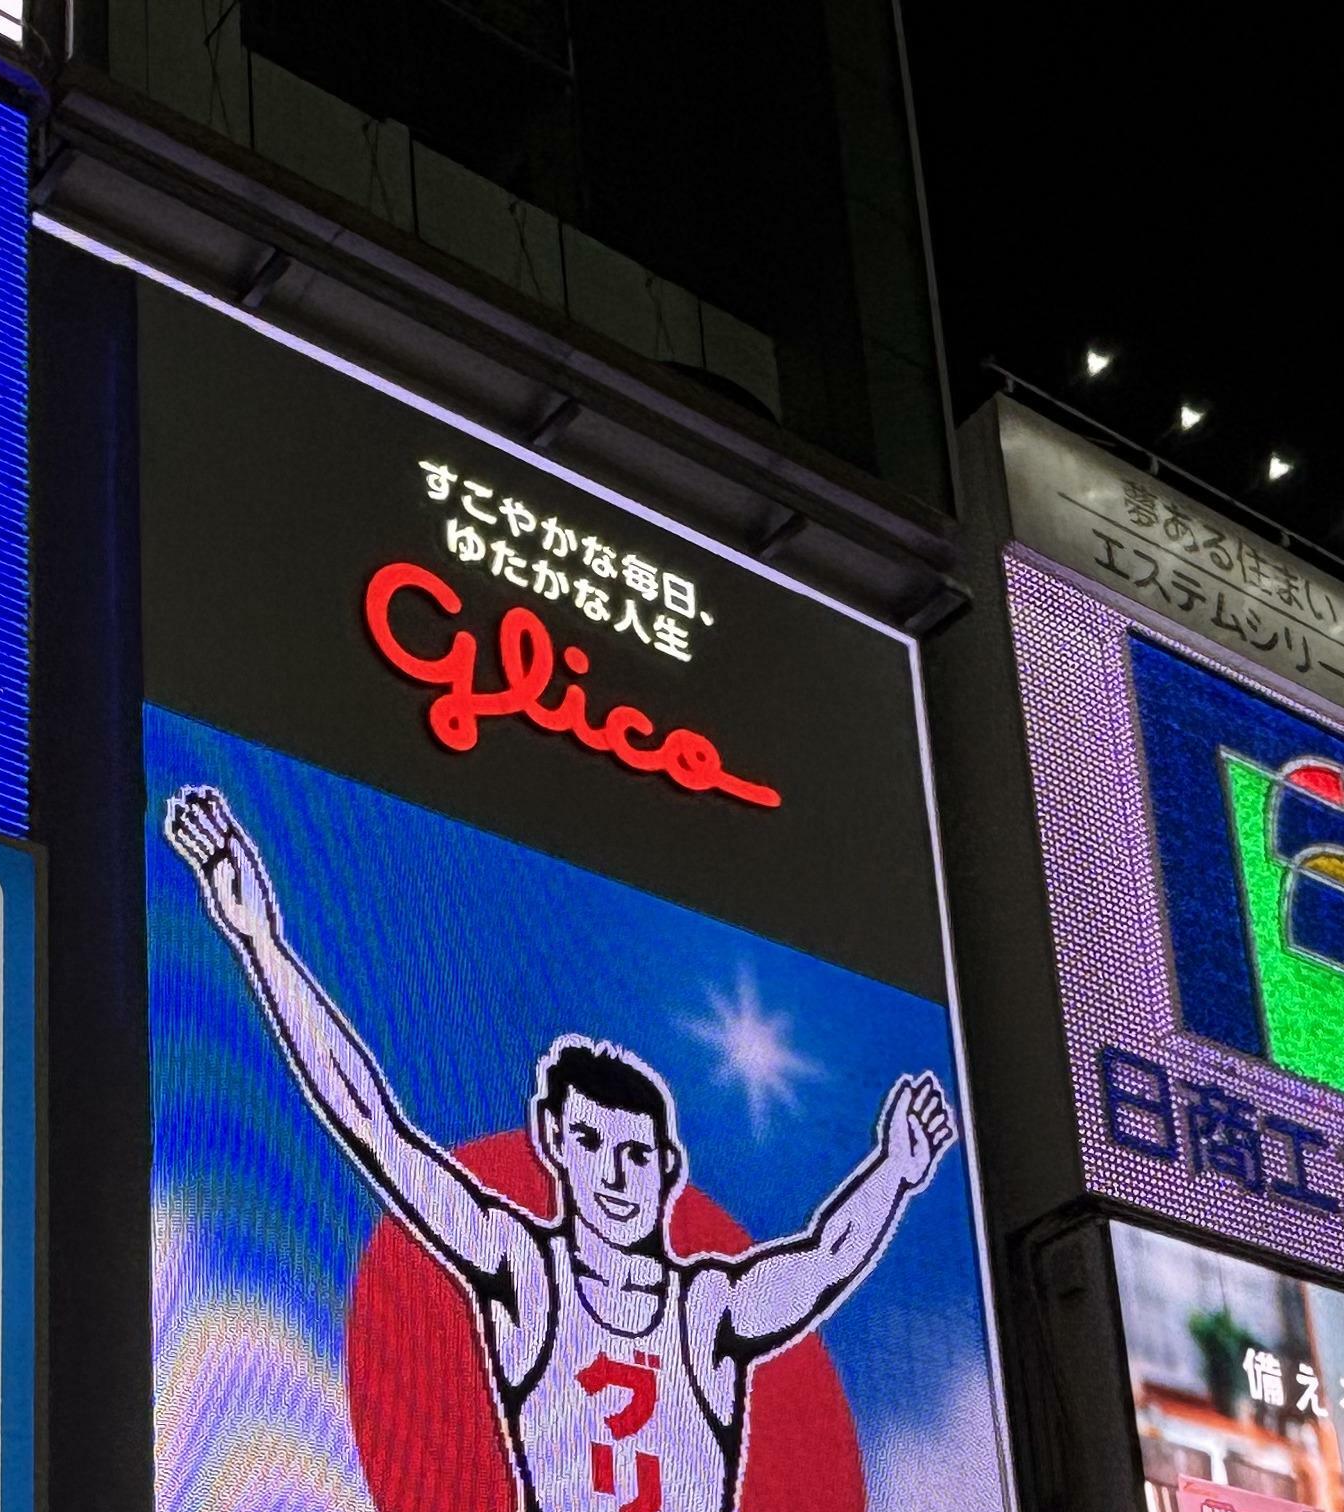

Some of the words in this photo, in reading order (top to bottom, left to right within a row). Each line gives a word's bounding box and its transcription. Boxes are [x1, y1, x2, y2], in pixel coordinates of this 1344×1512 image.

[417, 459, 714, 626] すこやかな毎日、
[446, 516, 692, 662] ゆたかな人生
